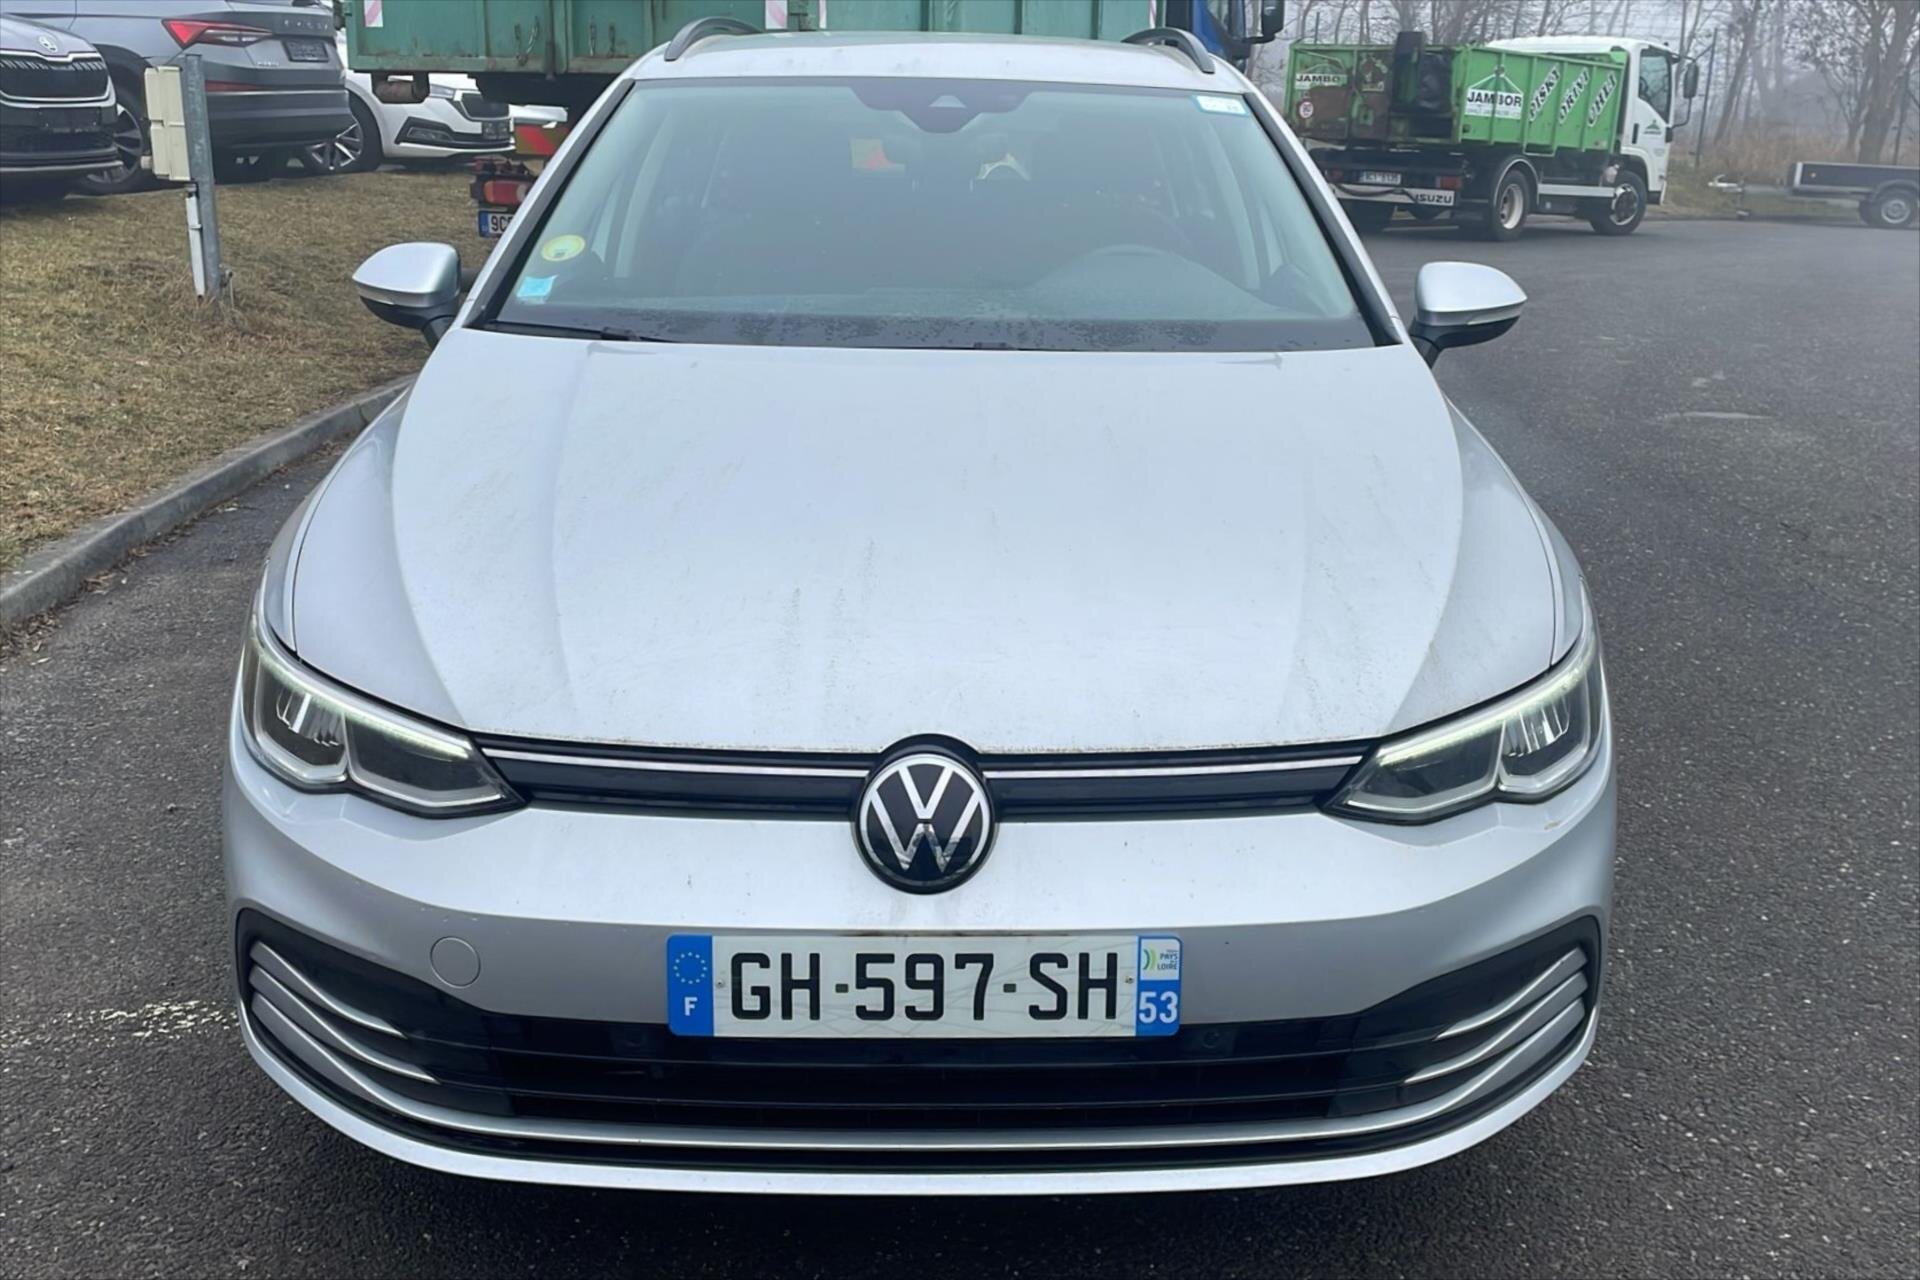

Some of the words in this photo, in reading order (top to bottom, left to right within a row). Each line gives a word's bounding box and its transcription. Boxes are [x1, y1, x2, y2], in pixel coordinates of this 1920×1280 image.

[1467, 91, 1522, 107] JAMBOR
[1415, 194, 1452, 204] ISUZU
[491, 215, 513, 232] 9C
[730, 952, 1119, 1021] GH-597-SH
[684, 996, 698, 1016] F
[1138, 991, 1178, 1024] 53
